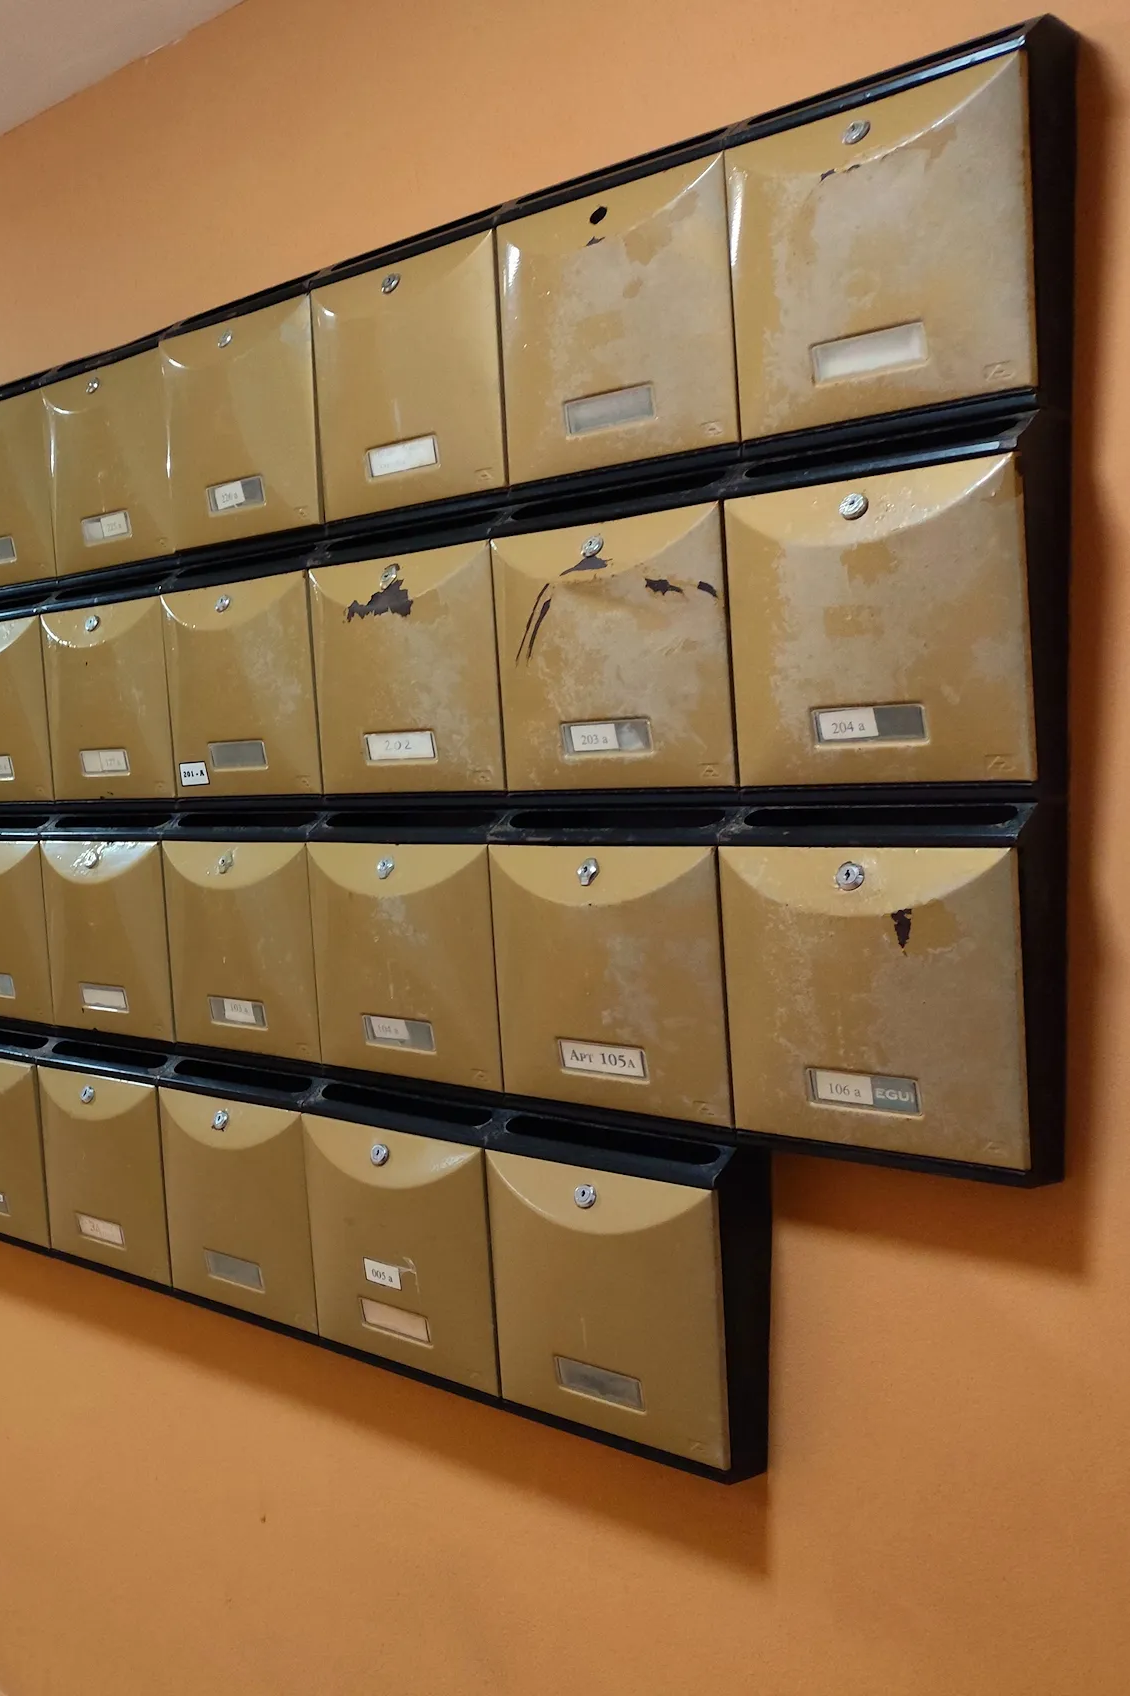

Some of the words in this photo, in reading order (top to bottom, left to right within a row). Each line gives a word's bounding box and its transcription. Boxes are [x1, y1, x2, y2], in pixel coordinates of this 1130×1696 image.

[831, 721, 855, 735] 204
[859, 722, 866, 732] a
[384, 739, 412, 751] 202
[581, 733, 599, 746] 203
[602, 735, 608, 744] a
[829, 1082, 851, 1097] 106
[854, 1087, 862, 1098] a
[371, 1268, 387, 1281] 005
[388, 1276, 394, 1284] a
